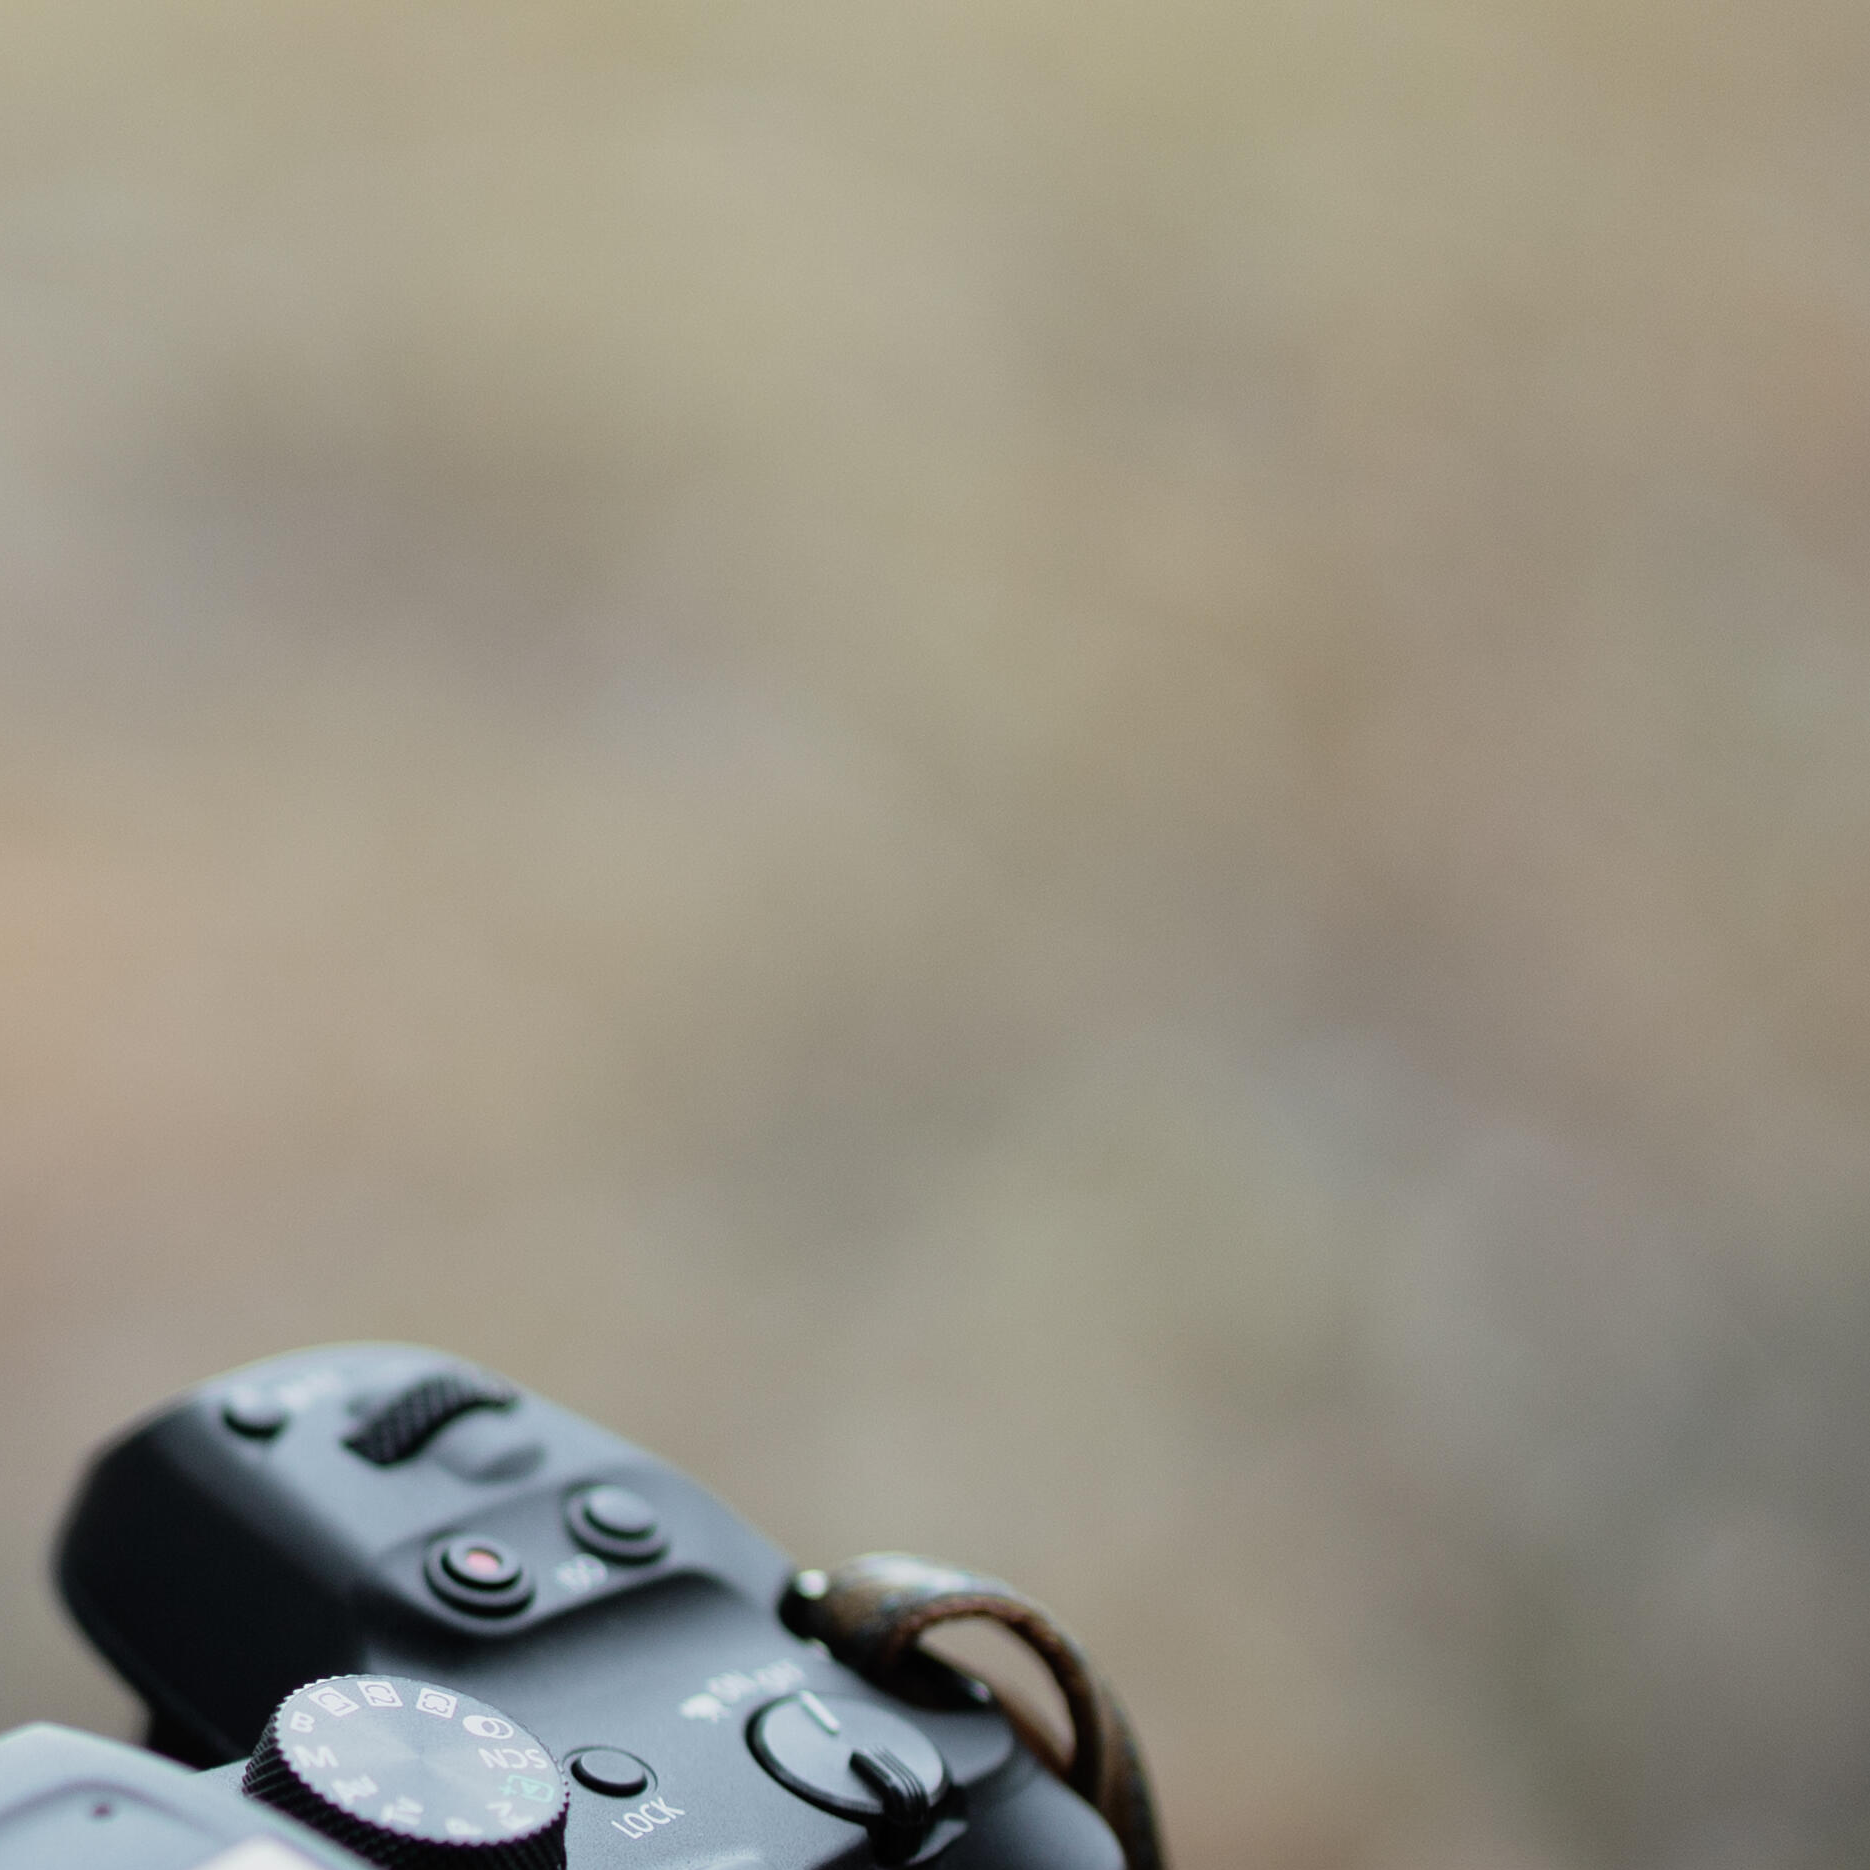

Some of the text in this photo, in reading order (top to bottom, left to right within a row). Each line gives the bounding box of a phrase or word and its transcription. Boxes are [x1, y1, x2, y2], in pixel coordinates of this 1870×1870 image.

[289, 1711, 315, 1733] B
[293, 1745, 339, 1768] M
[478, 1748, 547, 1770] SCN
[611, 1797, 685, 1840] LOCK
